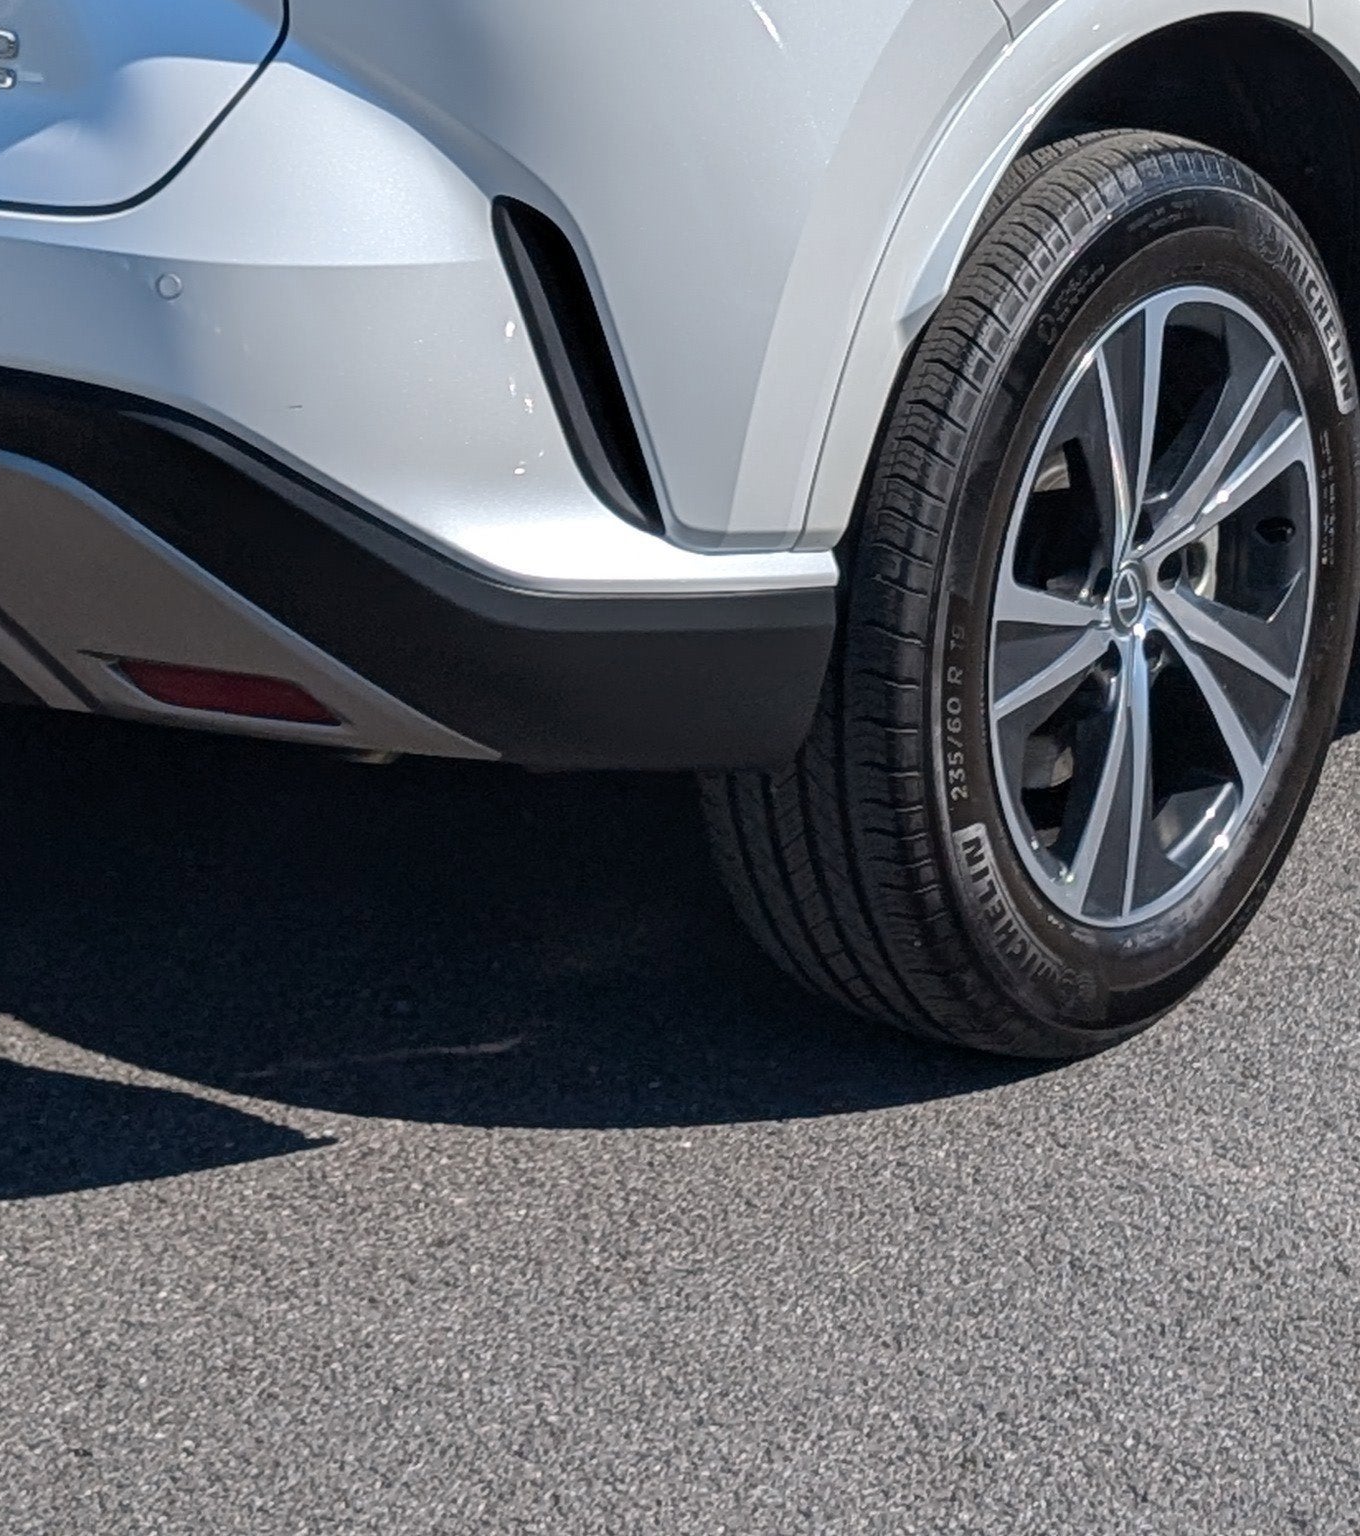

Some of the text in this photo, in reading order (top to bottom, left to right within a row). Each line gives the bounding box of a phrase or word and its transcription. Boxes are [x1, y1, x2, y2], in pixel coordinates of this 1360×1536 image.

[1280, 244, 1354, 403] MICHELIN
[946, 666, 964, 686] R
[946, 696, 969, 802] 235/60
[960, 835, 1061, 983] MICHELIN
